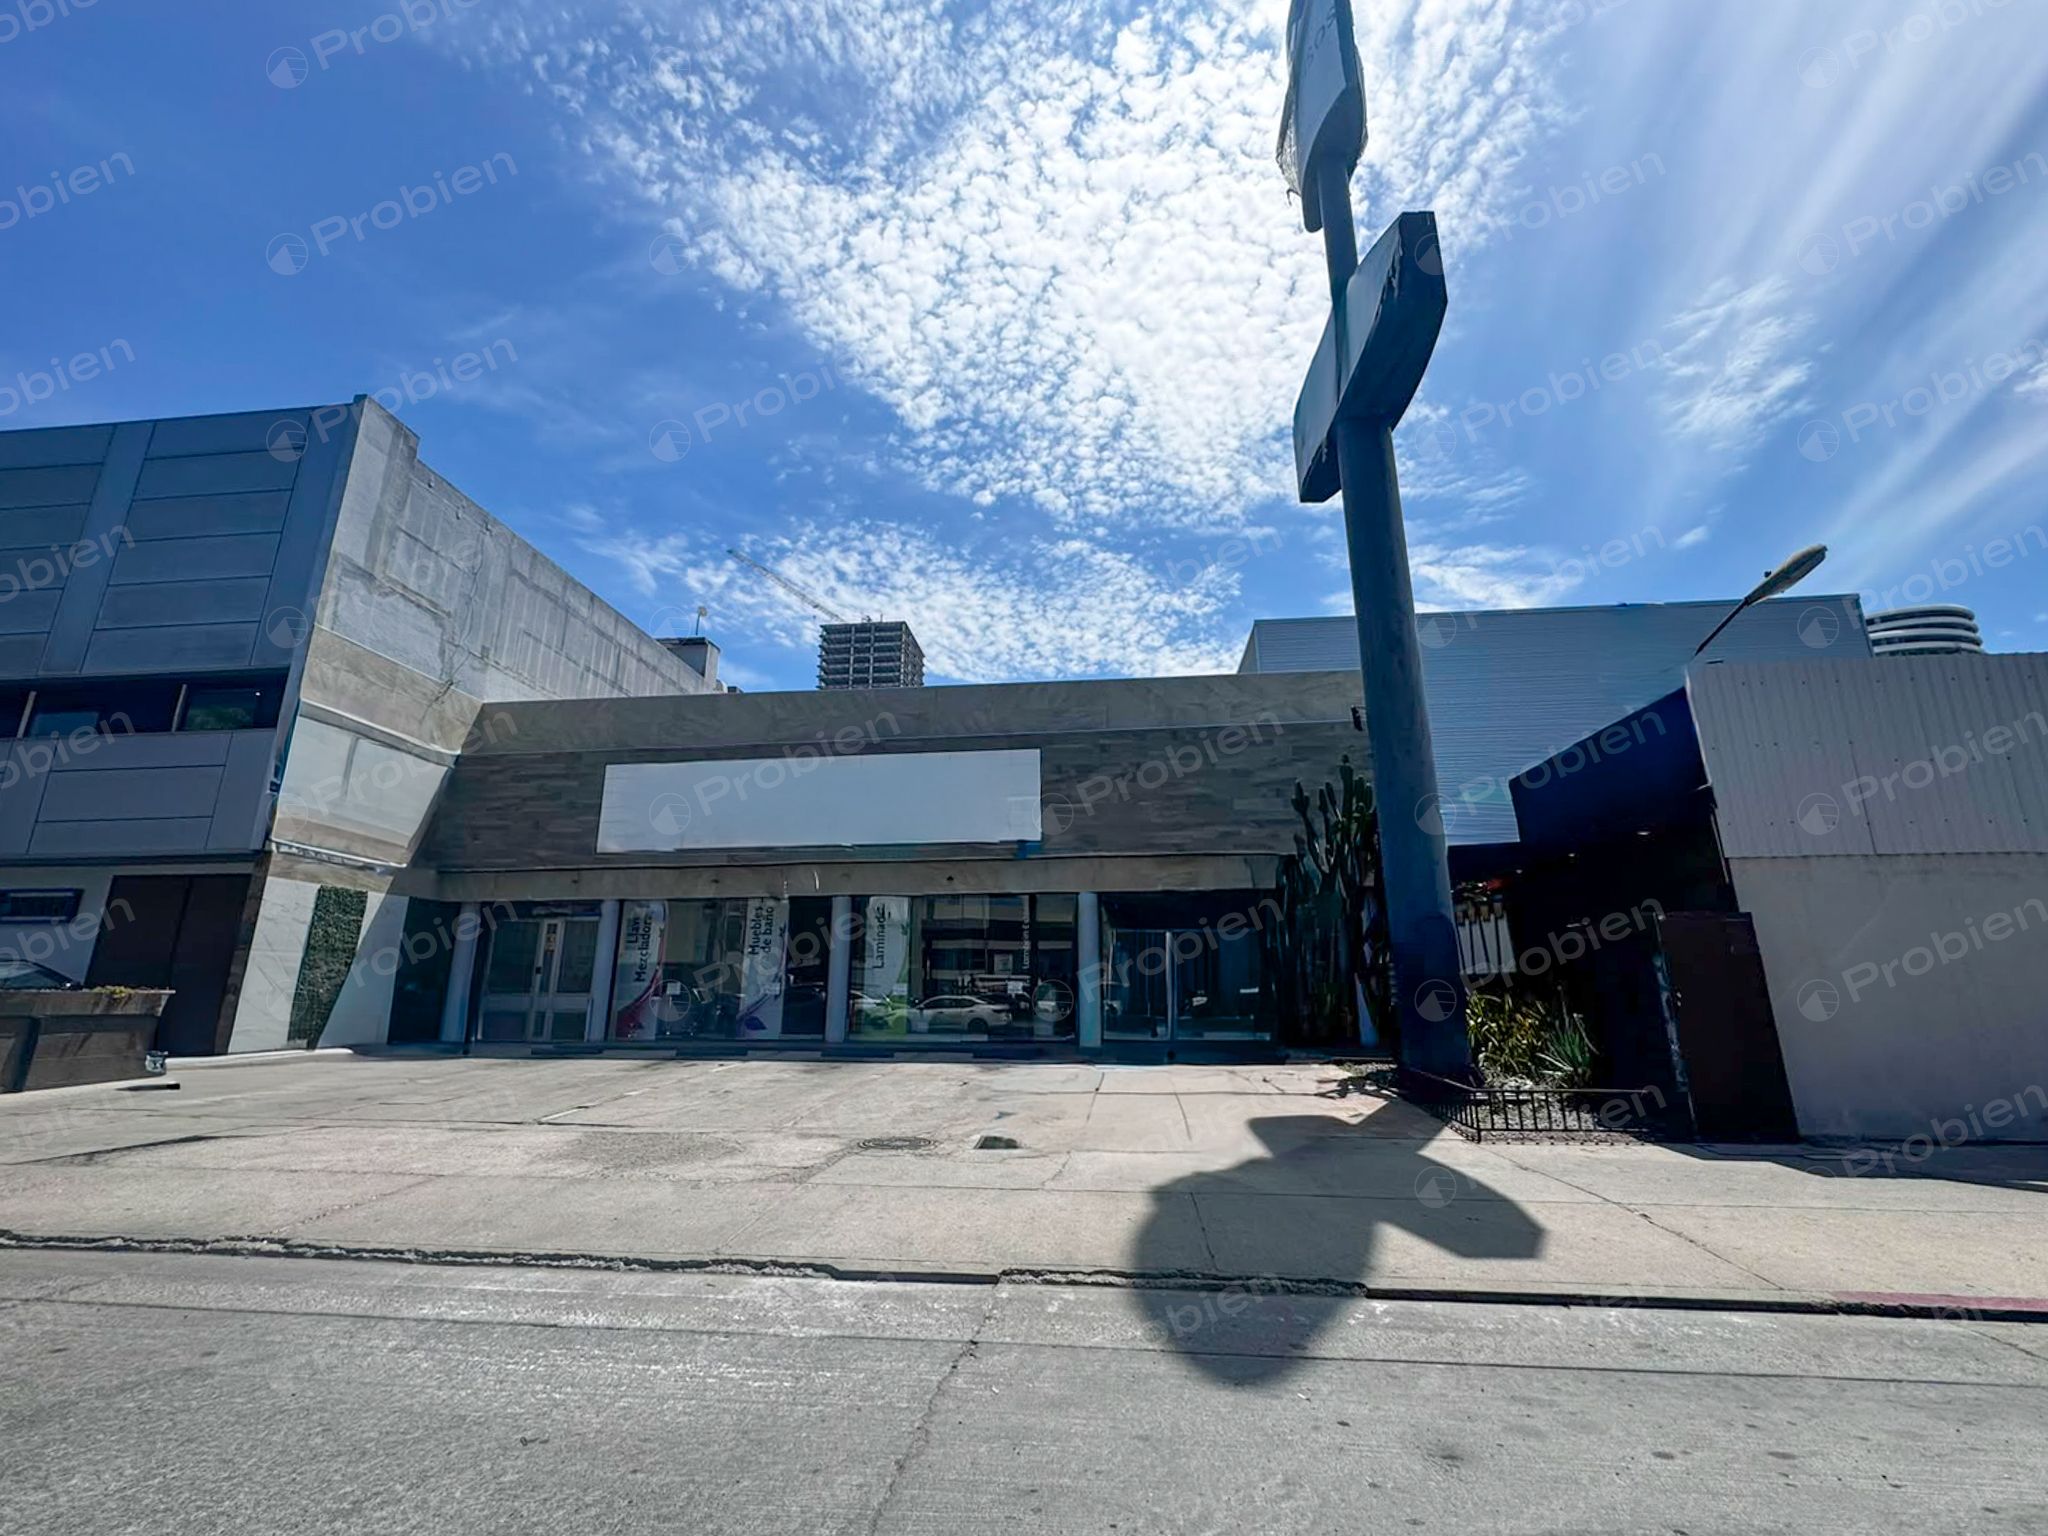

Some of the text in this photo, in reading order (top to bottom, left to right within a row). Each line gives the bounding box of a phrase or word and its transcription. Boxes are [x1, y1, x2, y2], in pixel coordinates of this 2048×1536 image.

[633, 915, 651, 983] Mezclador
[747, 905, 764, 955] Muebles
[760, 938, 772, 953] de
